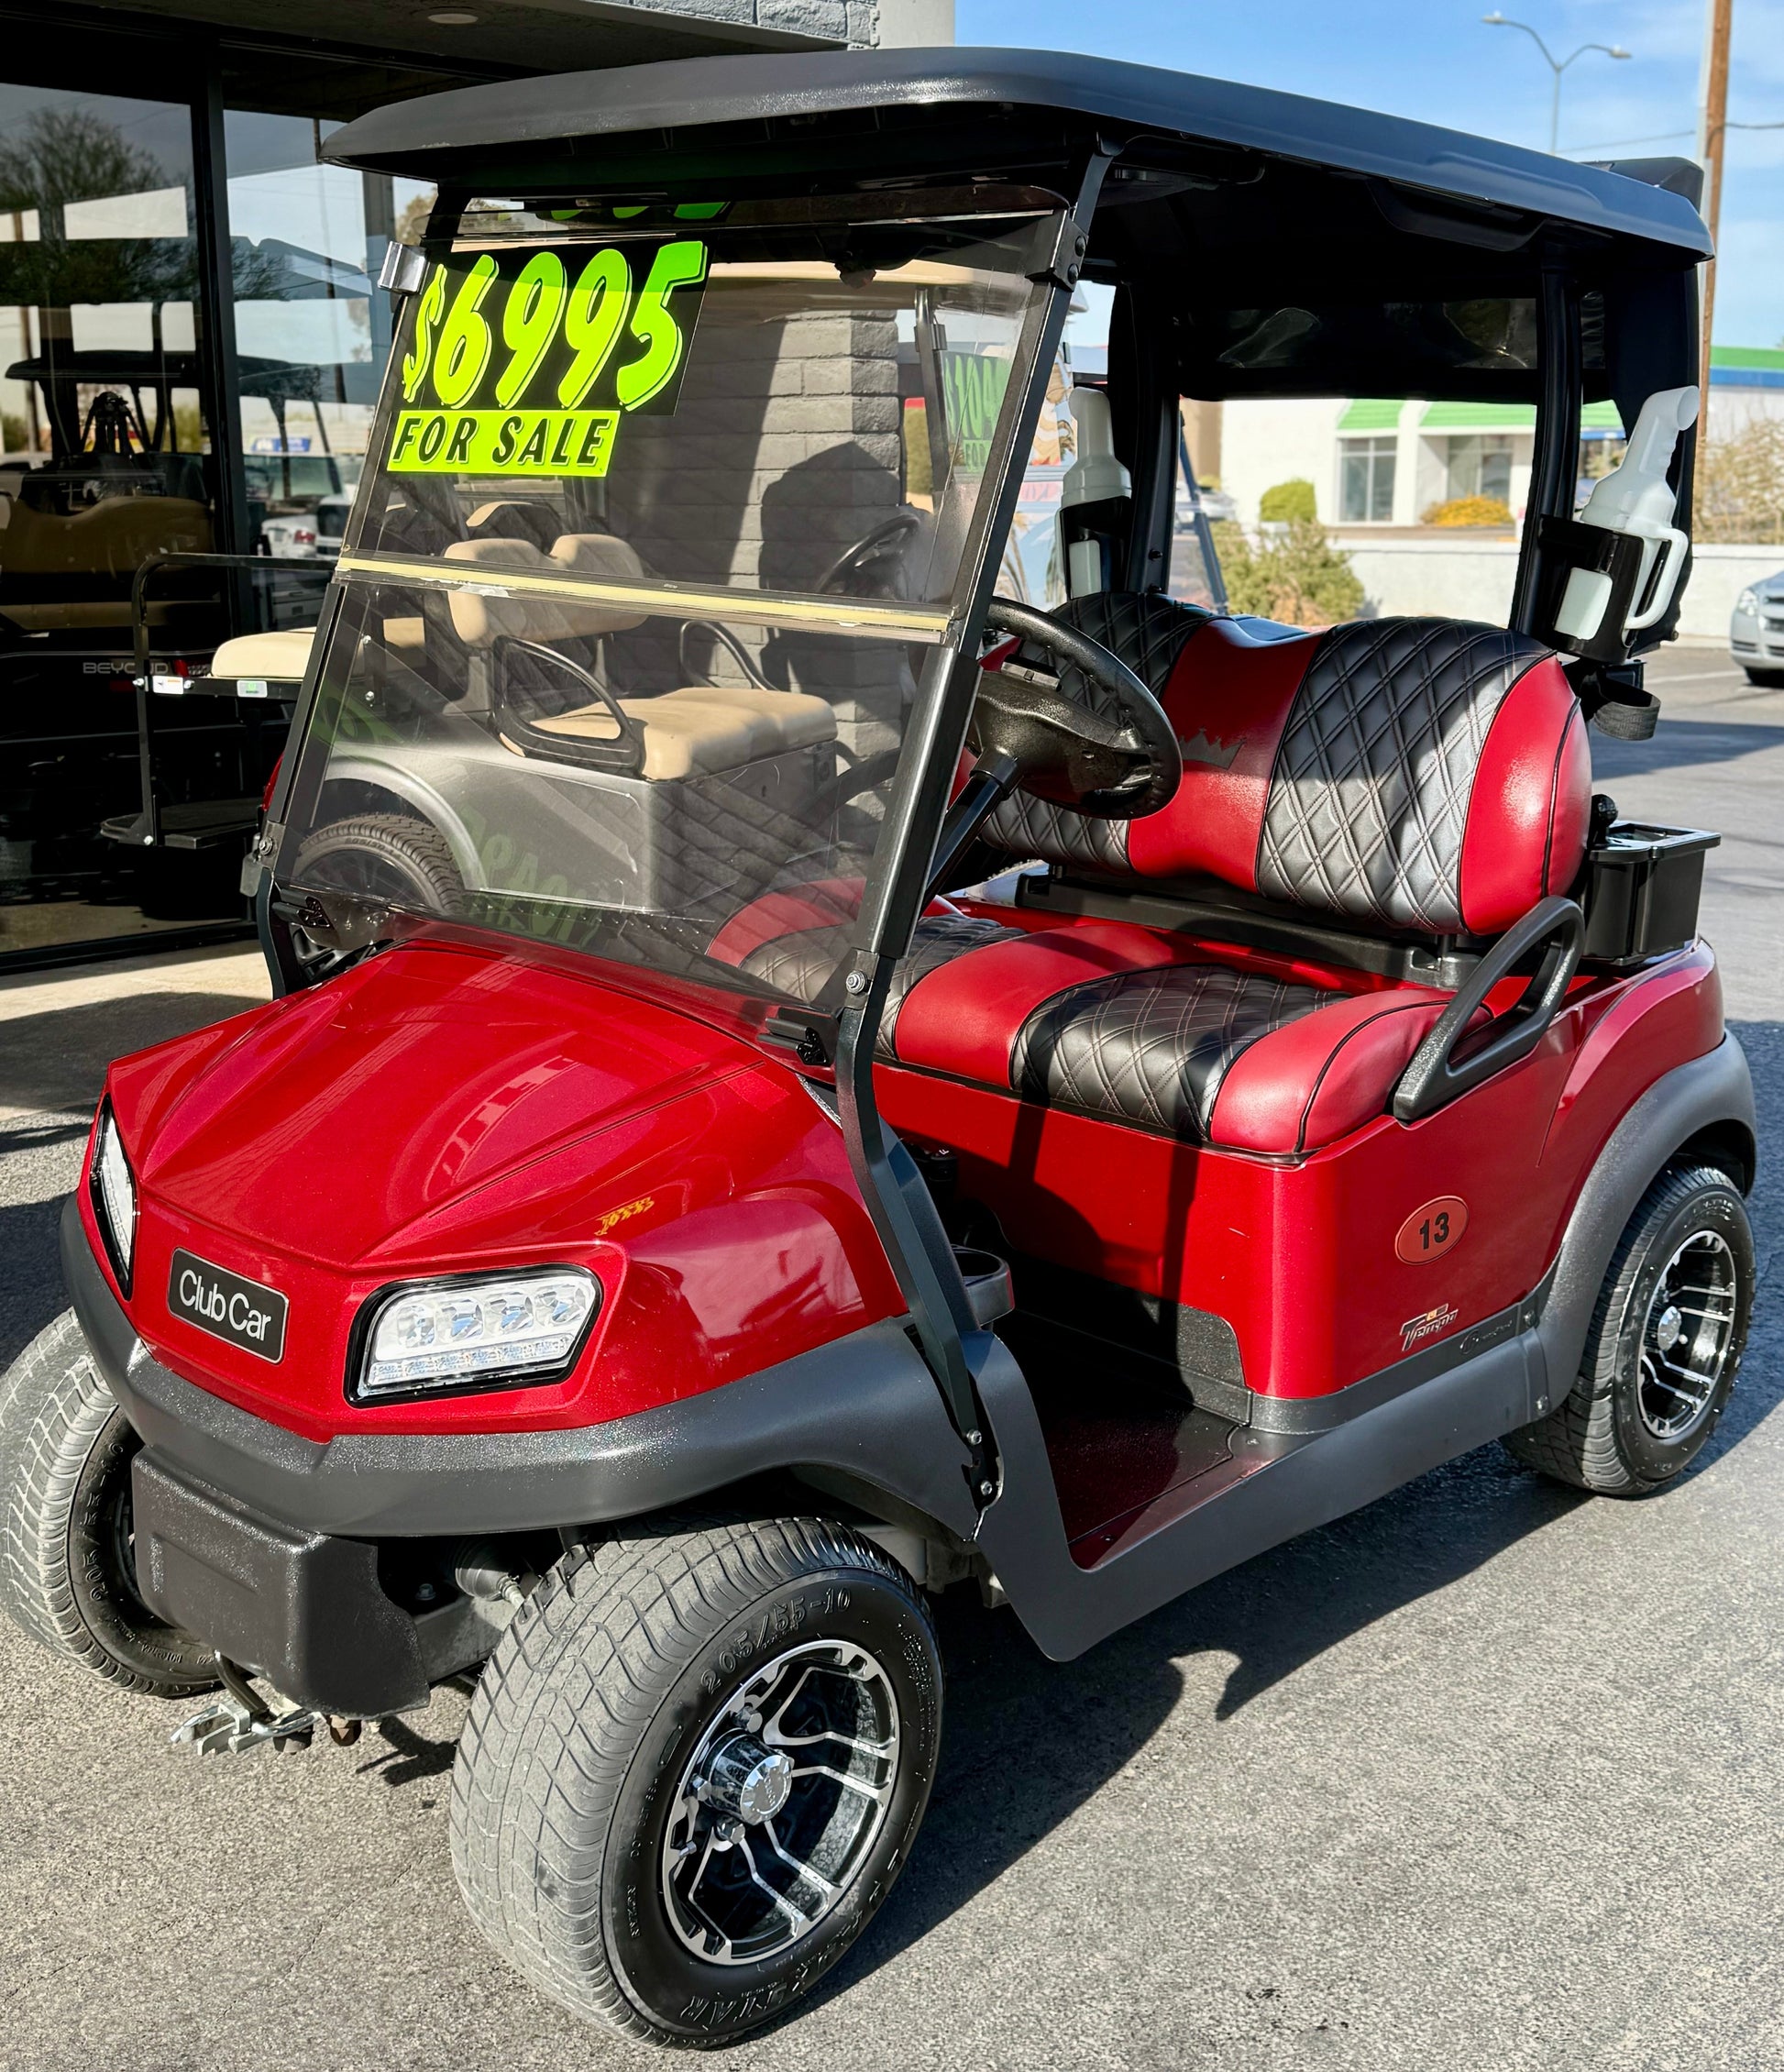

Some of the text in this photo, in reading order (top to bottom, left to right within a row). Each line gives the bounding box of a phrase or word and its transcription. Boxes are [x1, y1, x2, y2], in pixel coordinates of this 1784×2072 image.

[402, 240, 708, 412] $6995
[392, 415, 612, 468] FOR SALE
[83, 662, 169, 675] BEYOD
[1419, 1212, 1449, 1250] 13
[179, 1269, 272, 1341] Club Car
[700, 1587, 851, 1695] 205/55-10
